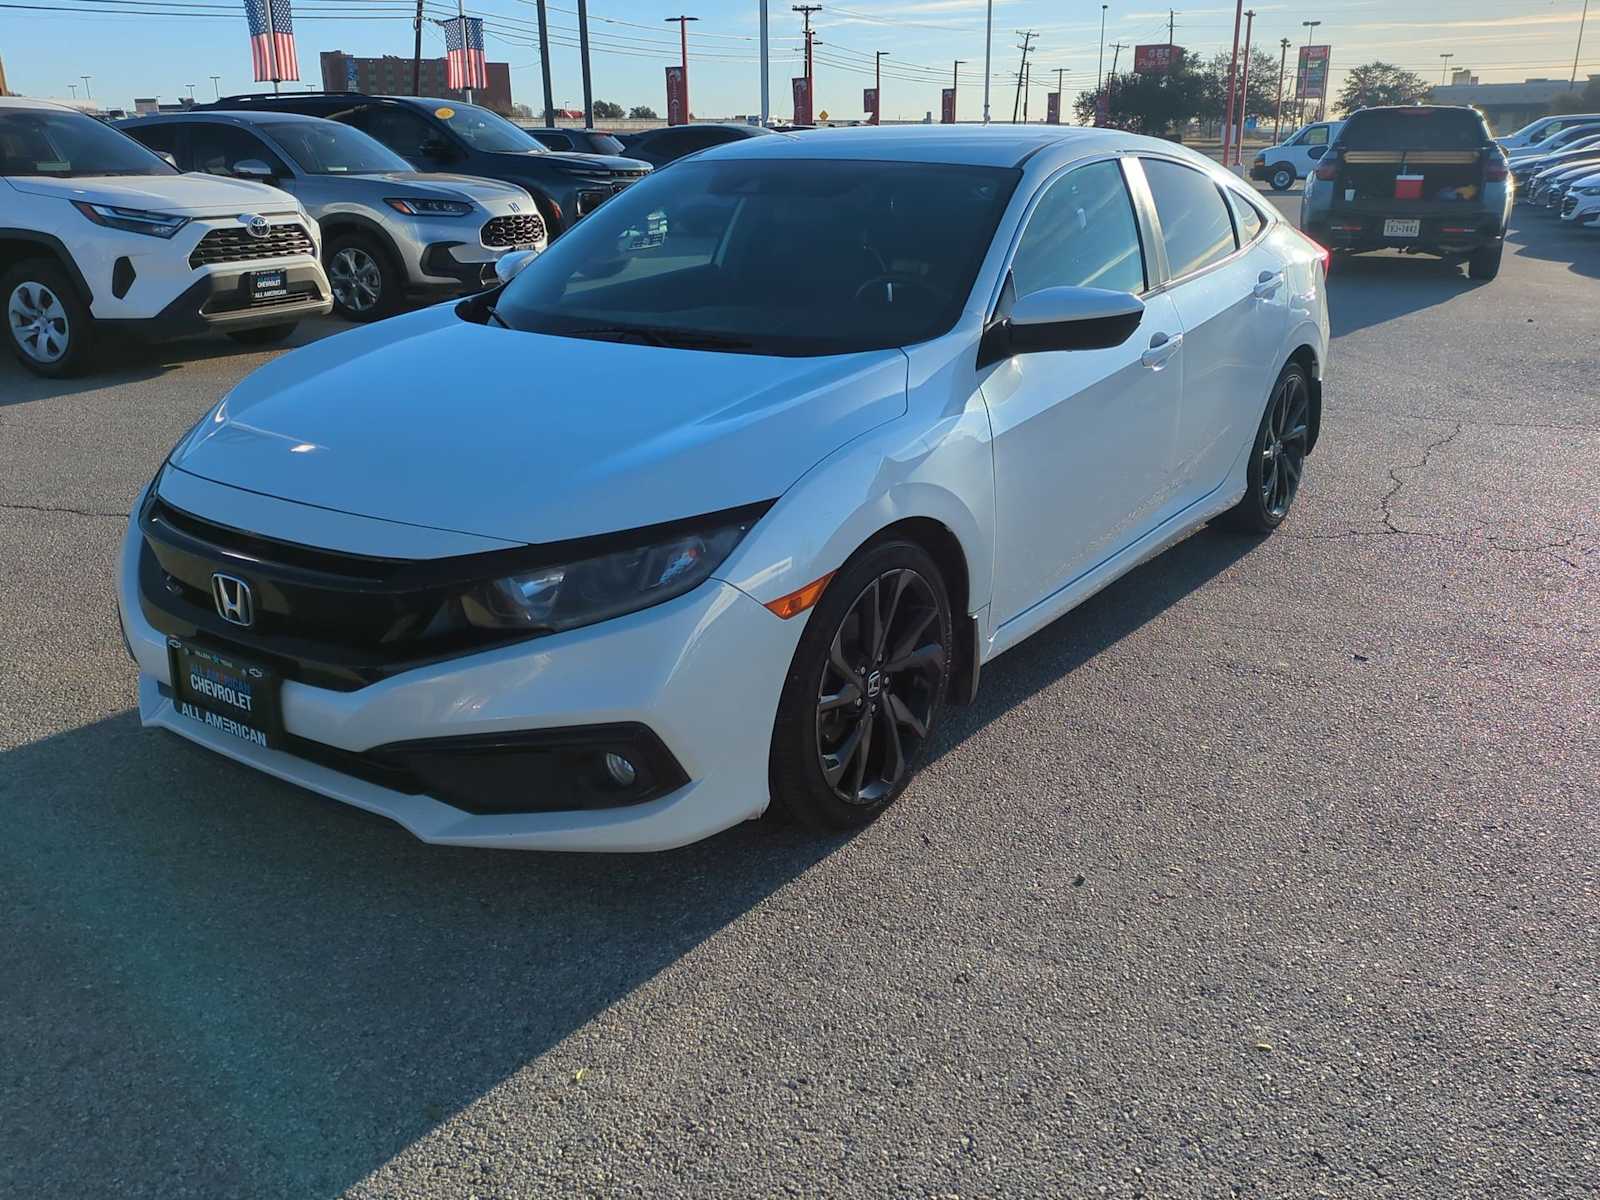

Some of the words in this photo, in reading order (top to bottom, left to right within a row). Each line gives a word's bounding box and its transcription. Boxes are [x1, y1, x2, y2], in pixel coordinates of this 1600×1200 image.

[190, 674, 252, 711] CHEVROLET
[182, 702, 204, 722] ALL
[205, 710, 267, 747] AMERICAN
